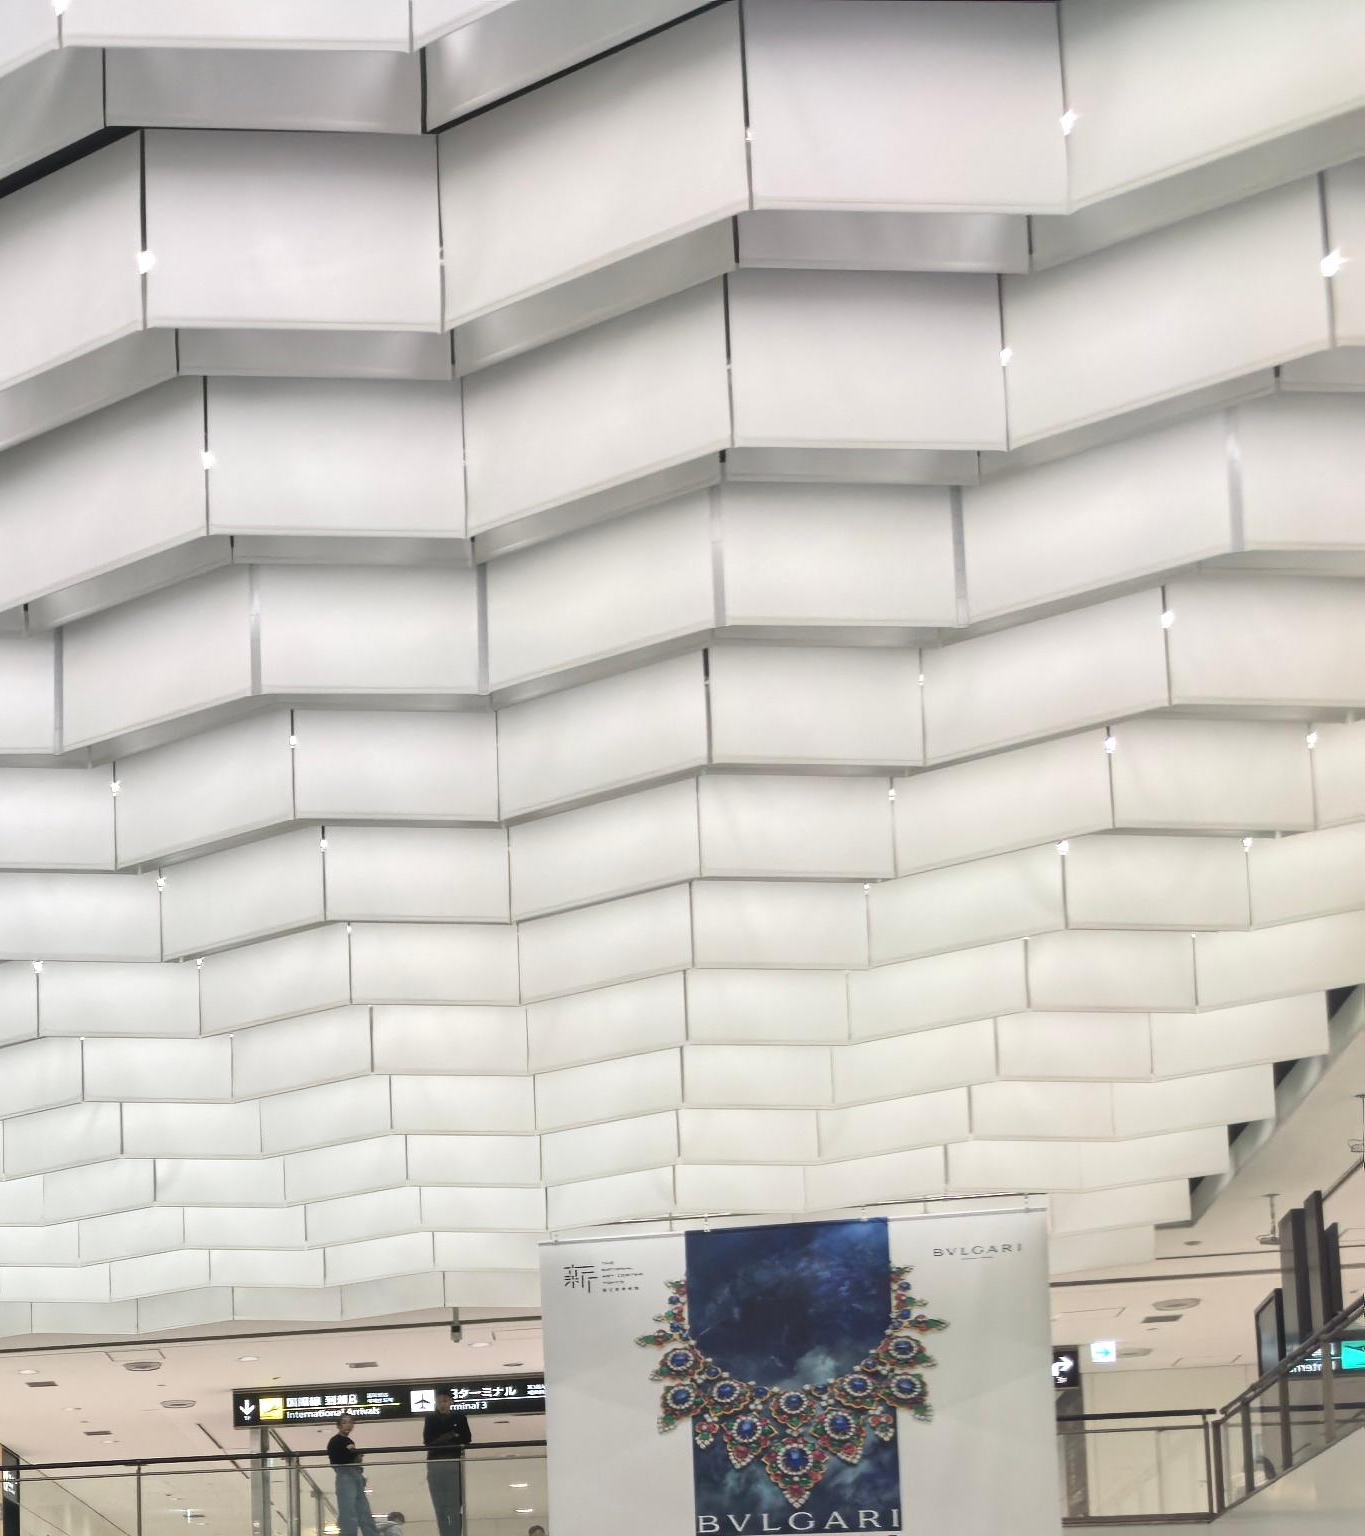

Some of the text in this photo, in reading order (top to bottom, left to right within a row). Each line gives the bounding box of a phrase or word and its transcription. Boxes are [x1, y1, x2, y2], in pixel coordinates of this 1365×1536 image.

[932, 1243, 1023, 1258] BVLGARI
[450, 1401, 477, 1412] rminal
[697, 1509, 902, 1533] BVLGARI
